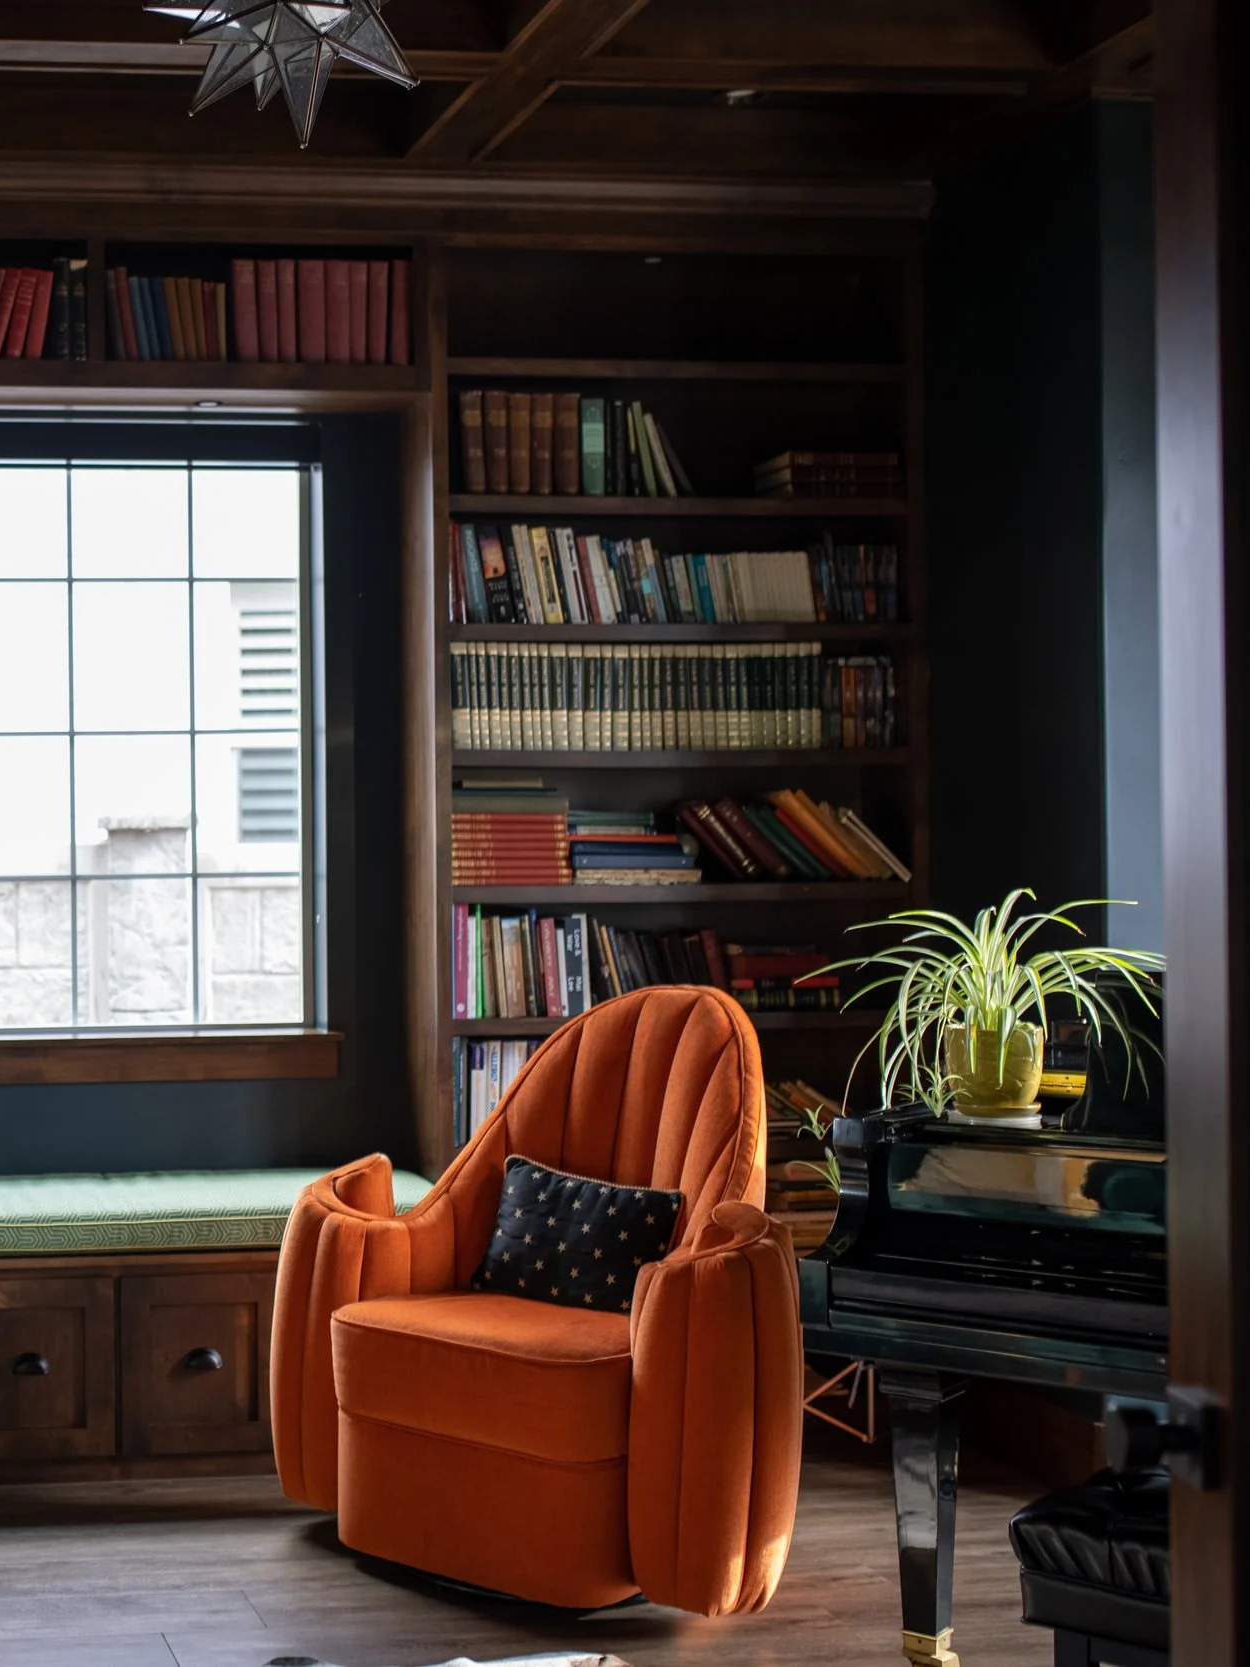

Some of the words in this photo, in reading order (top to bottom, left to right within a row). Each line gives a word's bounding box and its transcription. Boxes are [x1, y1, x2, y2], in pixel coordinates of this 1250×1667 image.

[465, 529, 479, 573] INSIGHTS
[566, 933, 574, 952] War
[573, 928, 581, 948] Love
[567, 976, 575, 992] Lee
